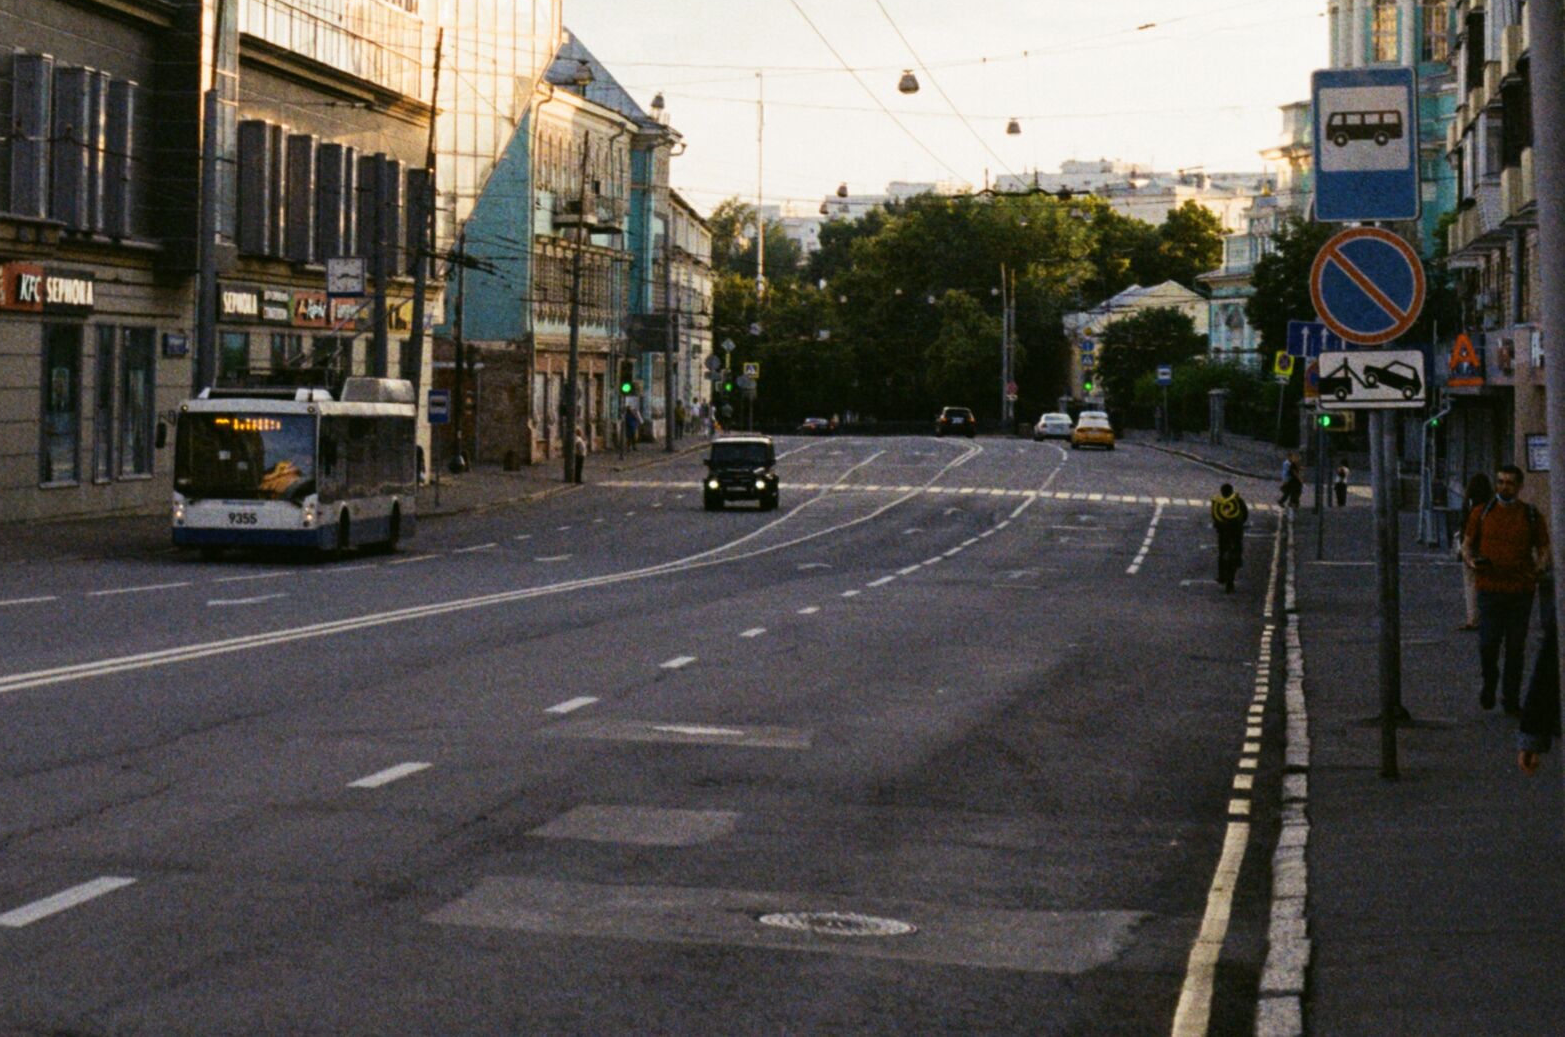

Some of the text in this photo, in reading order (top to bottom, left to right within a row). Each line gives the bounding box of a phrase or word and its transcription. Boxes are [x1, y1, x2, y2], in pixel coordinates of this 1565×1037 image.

[19, 273, 94, 305] KFC SEPHORA
[222, 291, 258, 315] SEPHORA
[228, 513, 258, 525] 9355
